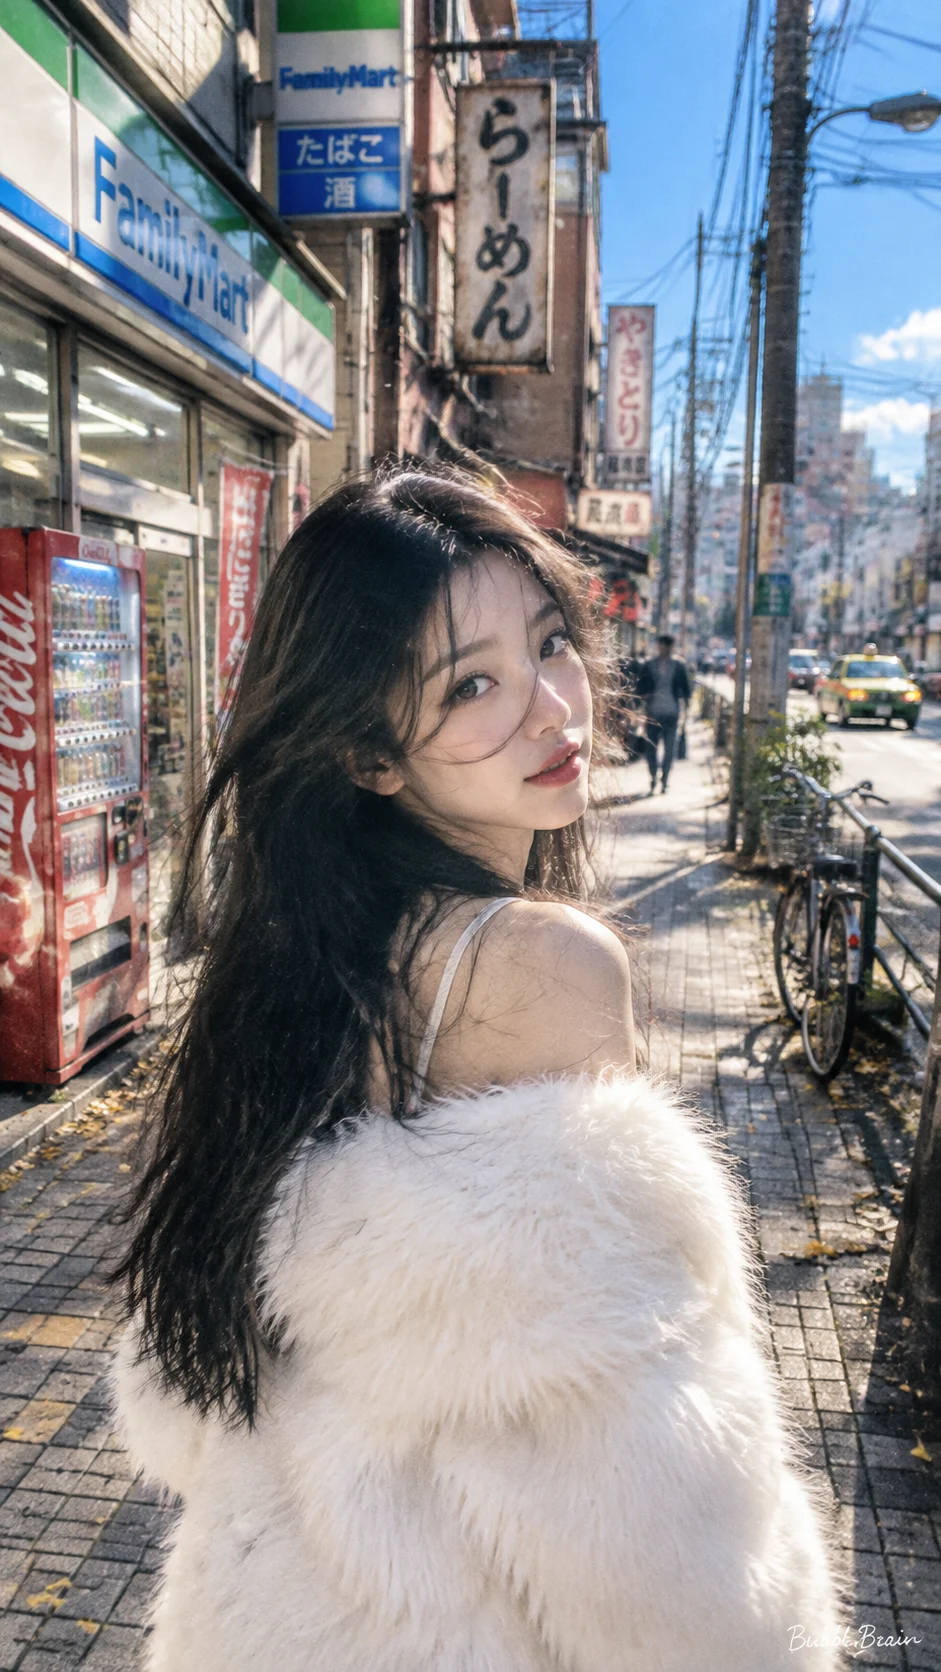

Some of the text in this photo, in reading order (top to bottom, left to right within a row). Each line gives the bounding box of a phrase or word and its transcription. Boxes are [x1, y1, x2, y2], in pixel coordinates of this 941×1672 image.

[279, 64, 397, 95] FamilyMart
[296, 133, 384, 166] たばこ
[324, 176, 356, 209] 酒
[471, 97, 532, 341] らーめん
[94, 136, 249, 334] FamilyMart
[615, 311, 646, 447] やきとり
